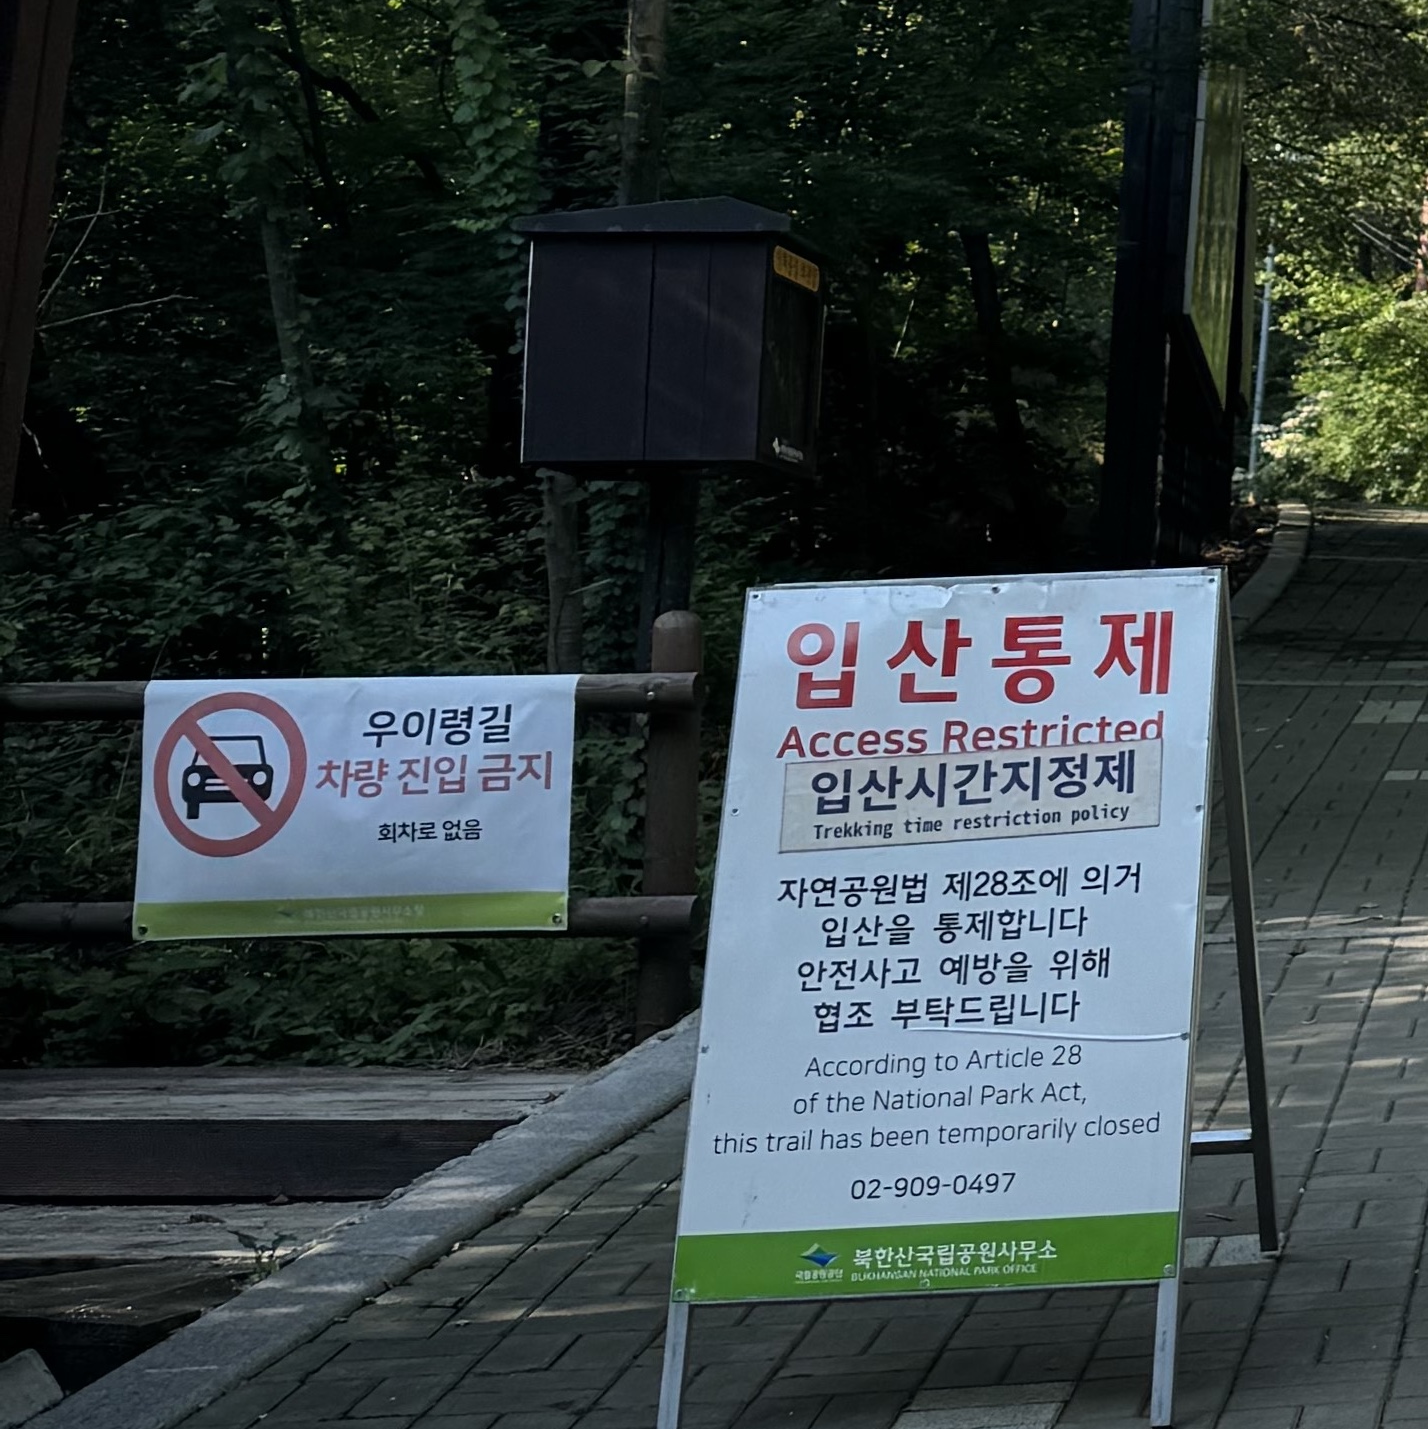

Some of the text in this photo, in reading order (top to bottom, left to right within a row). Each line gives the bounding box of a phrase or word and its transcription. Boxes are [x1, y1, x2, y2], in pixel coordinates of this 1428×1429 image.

[788, 611, 1173, 709] 입산통제
[363, 704, 511, 748] 우이령길
[776, 711, 1163, 759] Access Restricted
[315, 751, 552, 798] 차량 진입 금지
[811, 749, 1136, 816] 입산시간지정제
[378, 819, 482, 843] 회차로 없음
[814, 804, 1129, 839] Trekking time restriction policy
[777, 863, 1140, 908] 자연공원법 제28조에 의거
[822, 906, 1088, 948] 입산을 통제합니다
[798, 947, 1110, 991] 안전사고 예방을 위해
[814, 991, 1080, 1033] 협조 부탁드립니다
[805, 1045, 1081, 1078] According to Article 28
[794, 1082, 1086, 1114] of the National Park Act,
[714, 1111, 1160, 1154] this trail has been temporarily closed
[851, 1173, 1015, 1199] 02-909-0497
[853, 1239, 1058, 1270] 북한산국립공원사무소
